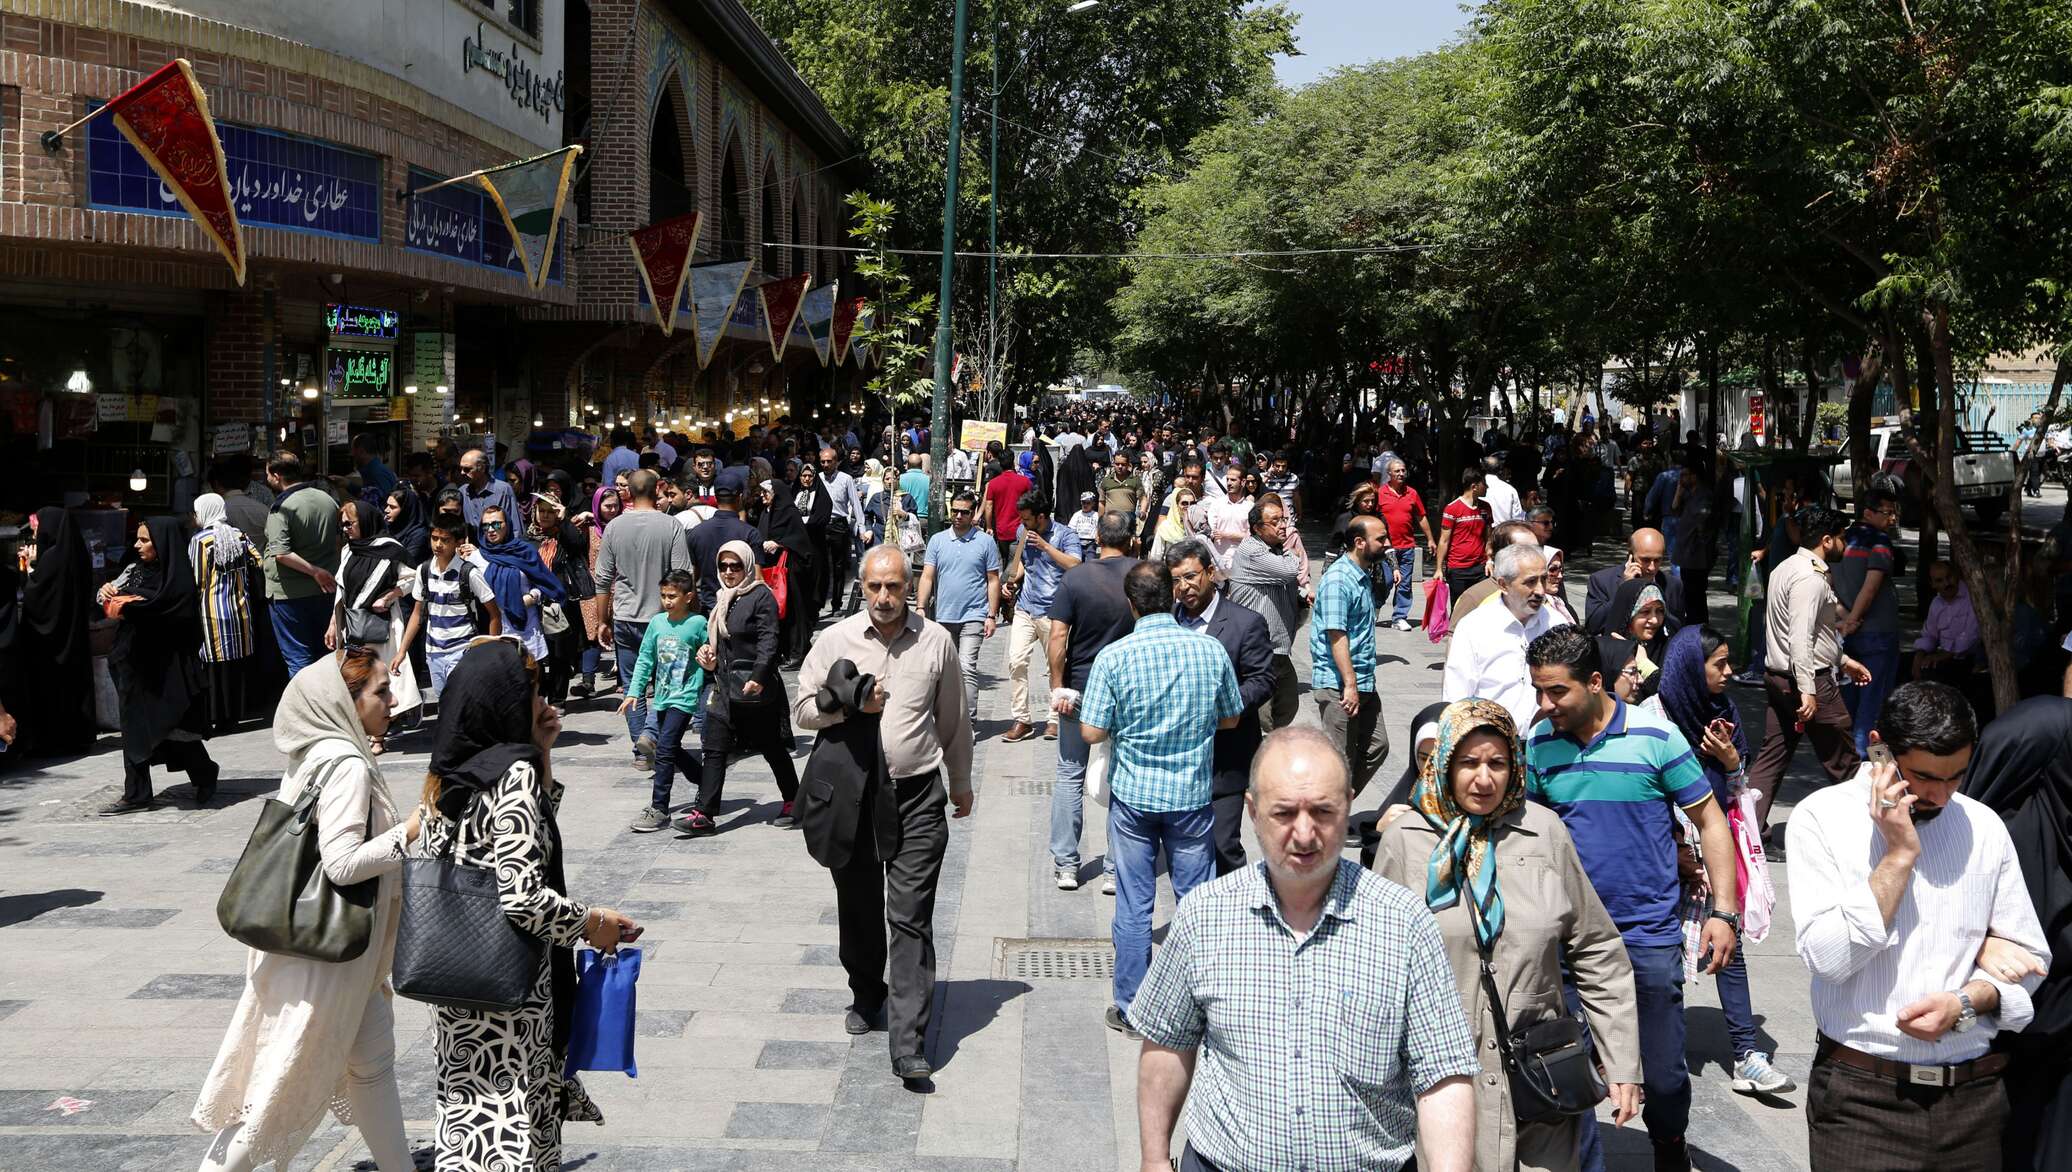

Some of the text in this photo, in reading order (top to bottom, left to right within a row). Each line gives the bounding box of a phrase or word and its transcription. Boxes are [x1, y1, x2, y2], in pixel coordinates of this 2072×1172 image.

[463, 22, 506, 78] مسلم
[303, 178, 349, 222] عطاری
[426, 208, 458, 247] خداوردیان
[456, 215, 477, 254] عطاری
[376, 357, 389, 391] آش
